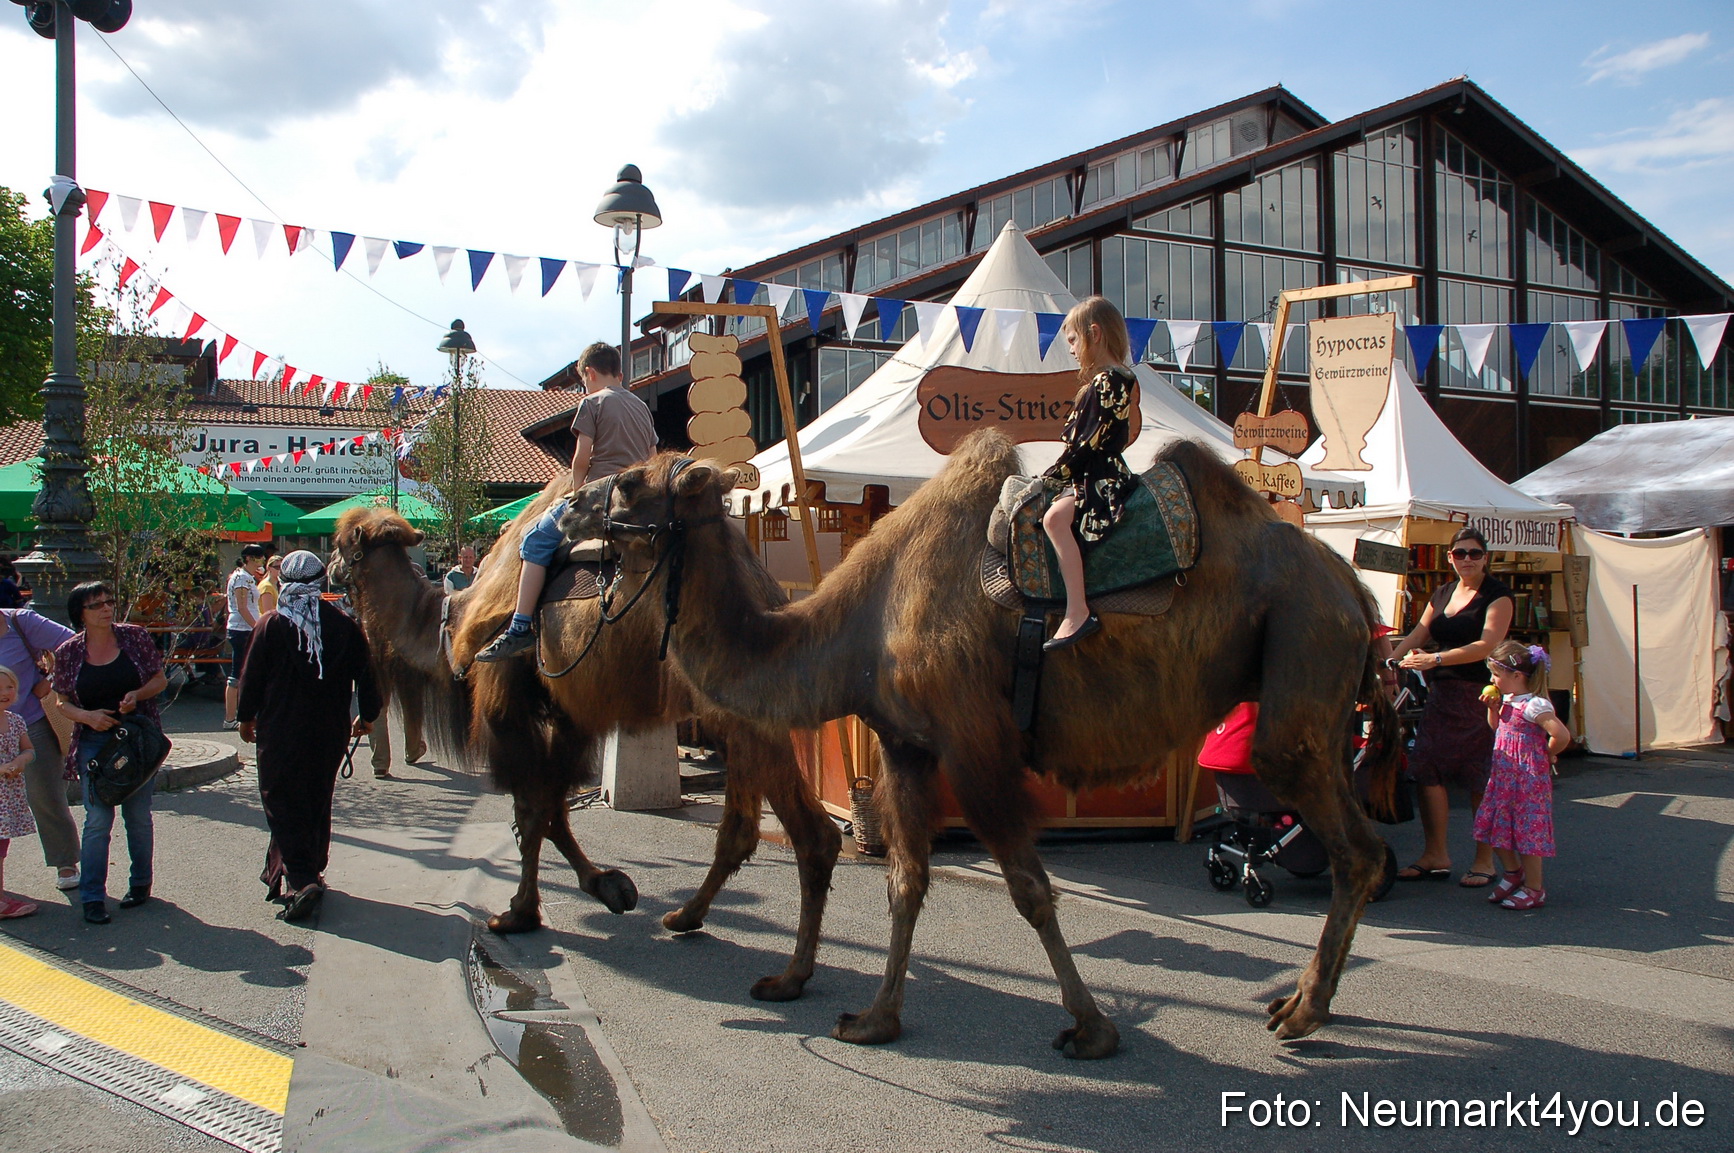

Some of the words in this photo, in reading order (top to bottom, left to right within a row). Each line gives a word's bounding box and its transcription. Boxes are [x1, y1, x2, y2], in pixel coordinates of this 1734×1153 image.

[1315, 364, 1388, 380] Gewürzweine
[926, 393, 1076, 421] Olis-Striez
[1234, 424, 1307, 439] Gewürzweine
[190, 433, 260, 453] Jura
[287, 436, 383, 457] Hallen
[289, 477, 346, 485] angenehmen
